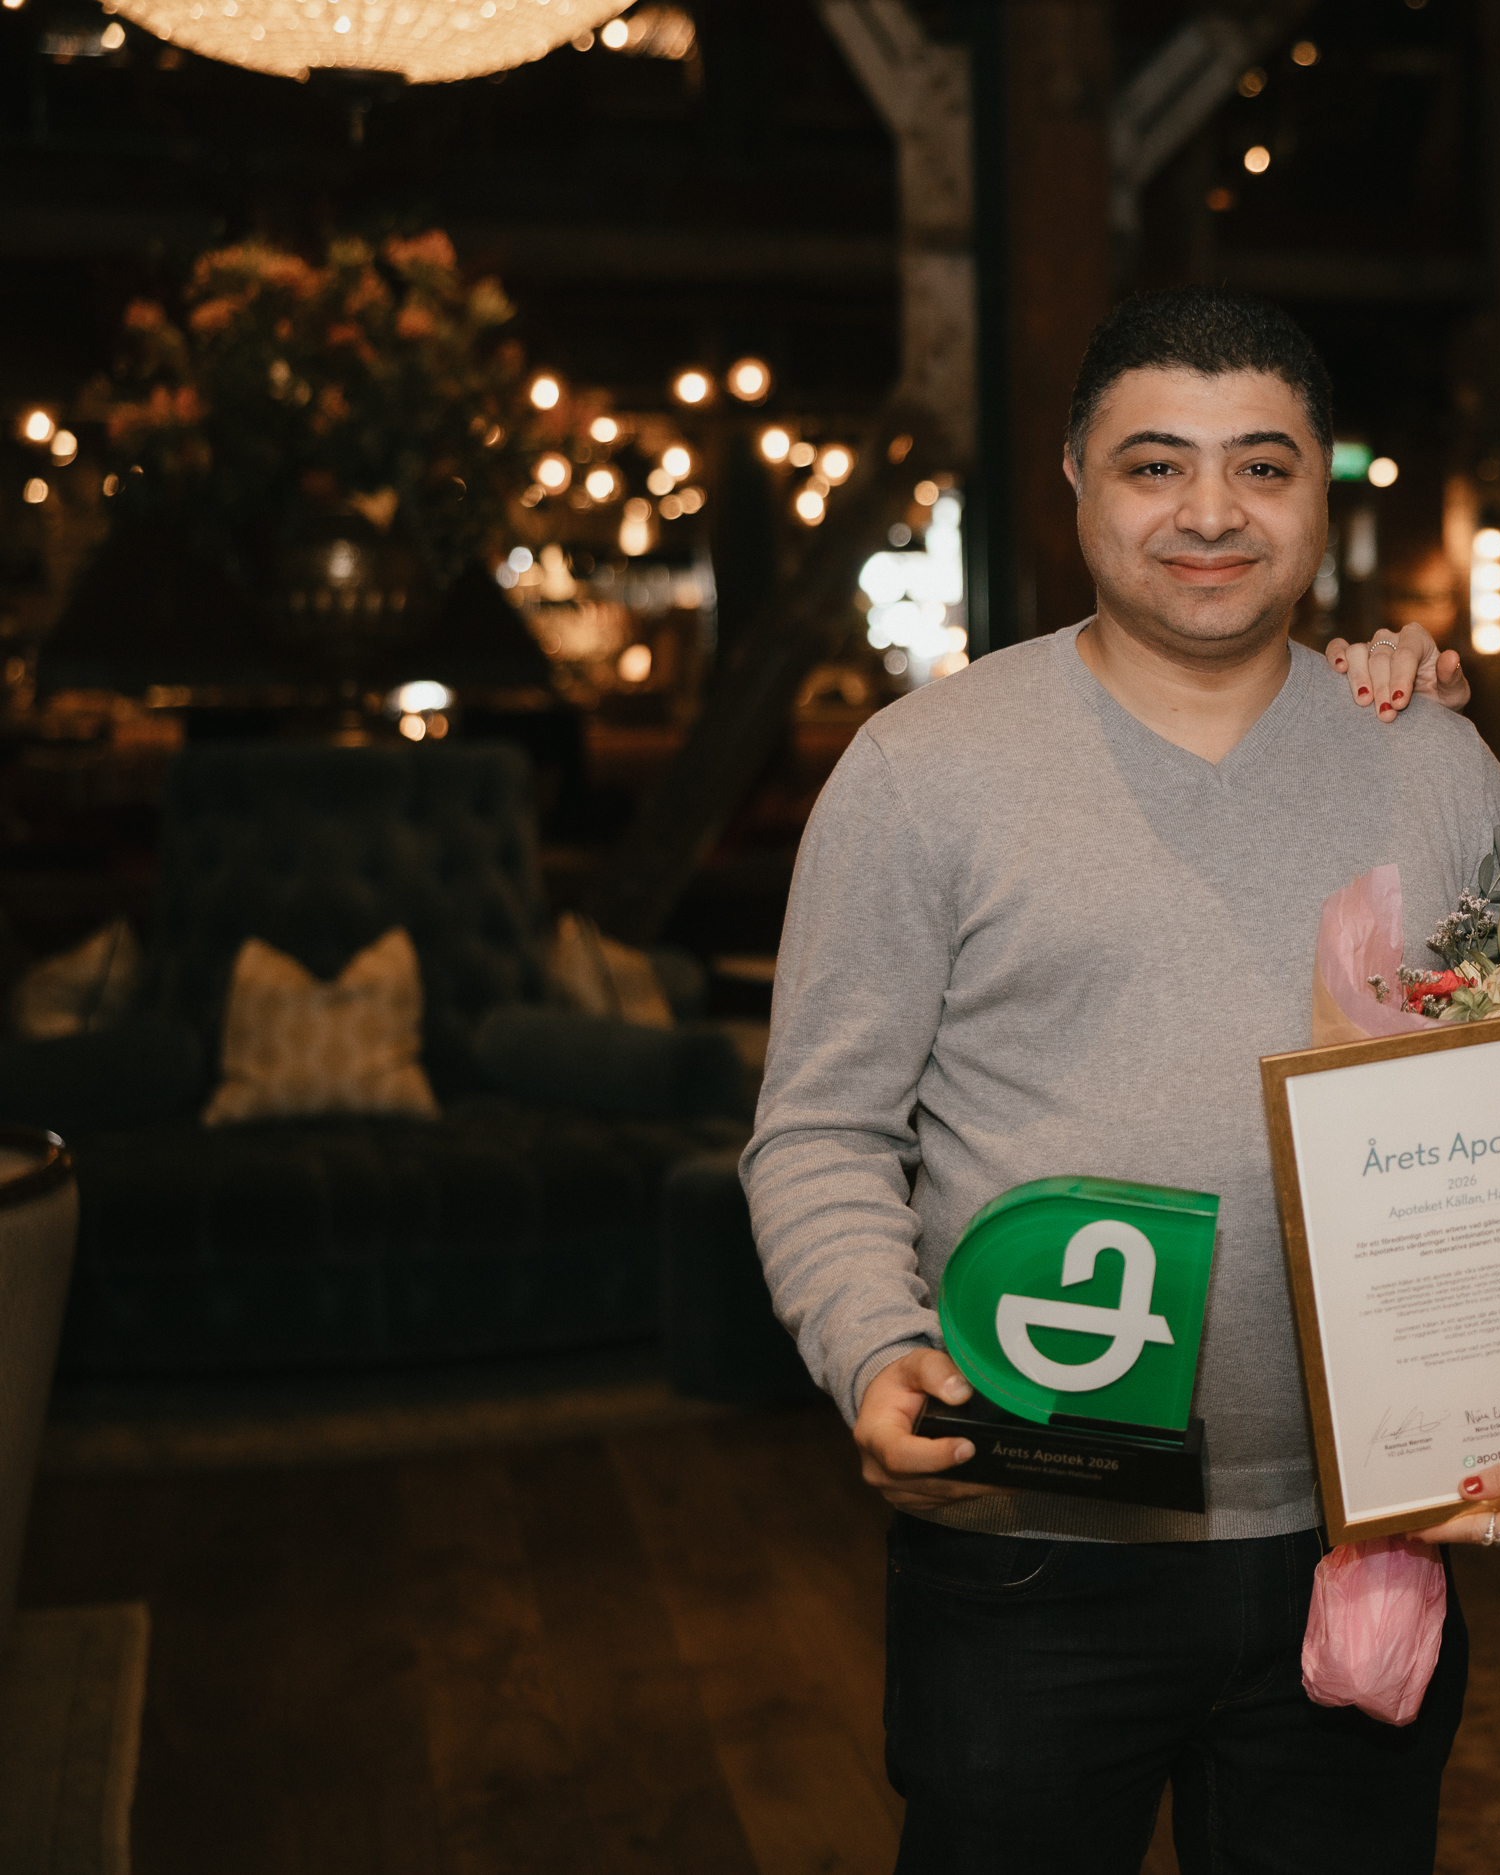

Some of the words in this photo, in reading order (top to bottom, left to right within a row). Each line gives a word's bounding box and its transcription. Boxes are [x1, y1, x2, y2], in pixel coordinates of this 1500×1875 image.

[1362, 1138, 1440, 1177] Årets
[1448, 1174, 1477, 1190] 2026
[1389, 1200, 1442, 1219] Apoteket
[1446, 1194, 1485, 1208] Källan,
[1353, 1251, 1368, 1259] och
[1369, 1246, 1405, 1256] Apotekets
[1406, 1239, 1445, 1249] värderingar
[1451, 1230, 1494, 1241] kombination
[1355, 1241, 1368, 1249] För
[1381, 1233, 1422, 1244] föredömligt
[1423, 1228, 1443, 1237] utfört
[1444, 1224, 1467, 1233] arbete
[1468, 1221, 1481, 1229] vad
[1482, 1218, 1500, 1227] gäller
[1419, 1249, 1433, 1257] den
[1434, 1244, 1467, 1254] operativa
[1469, 1239, 1492, 1249] planen
[992, 1441, 1030, 1459] Årets
[1033, 1449, 1084, 1466] Apotek
[1088, 1457, 1119, 1471] 2026
[1006, 1462, 1042, 1473] Apoteket
